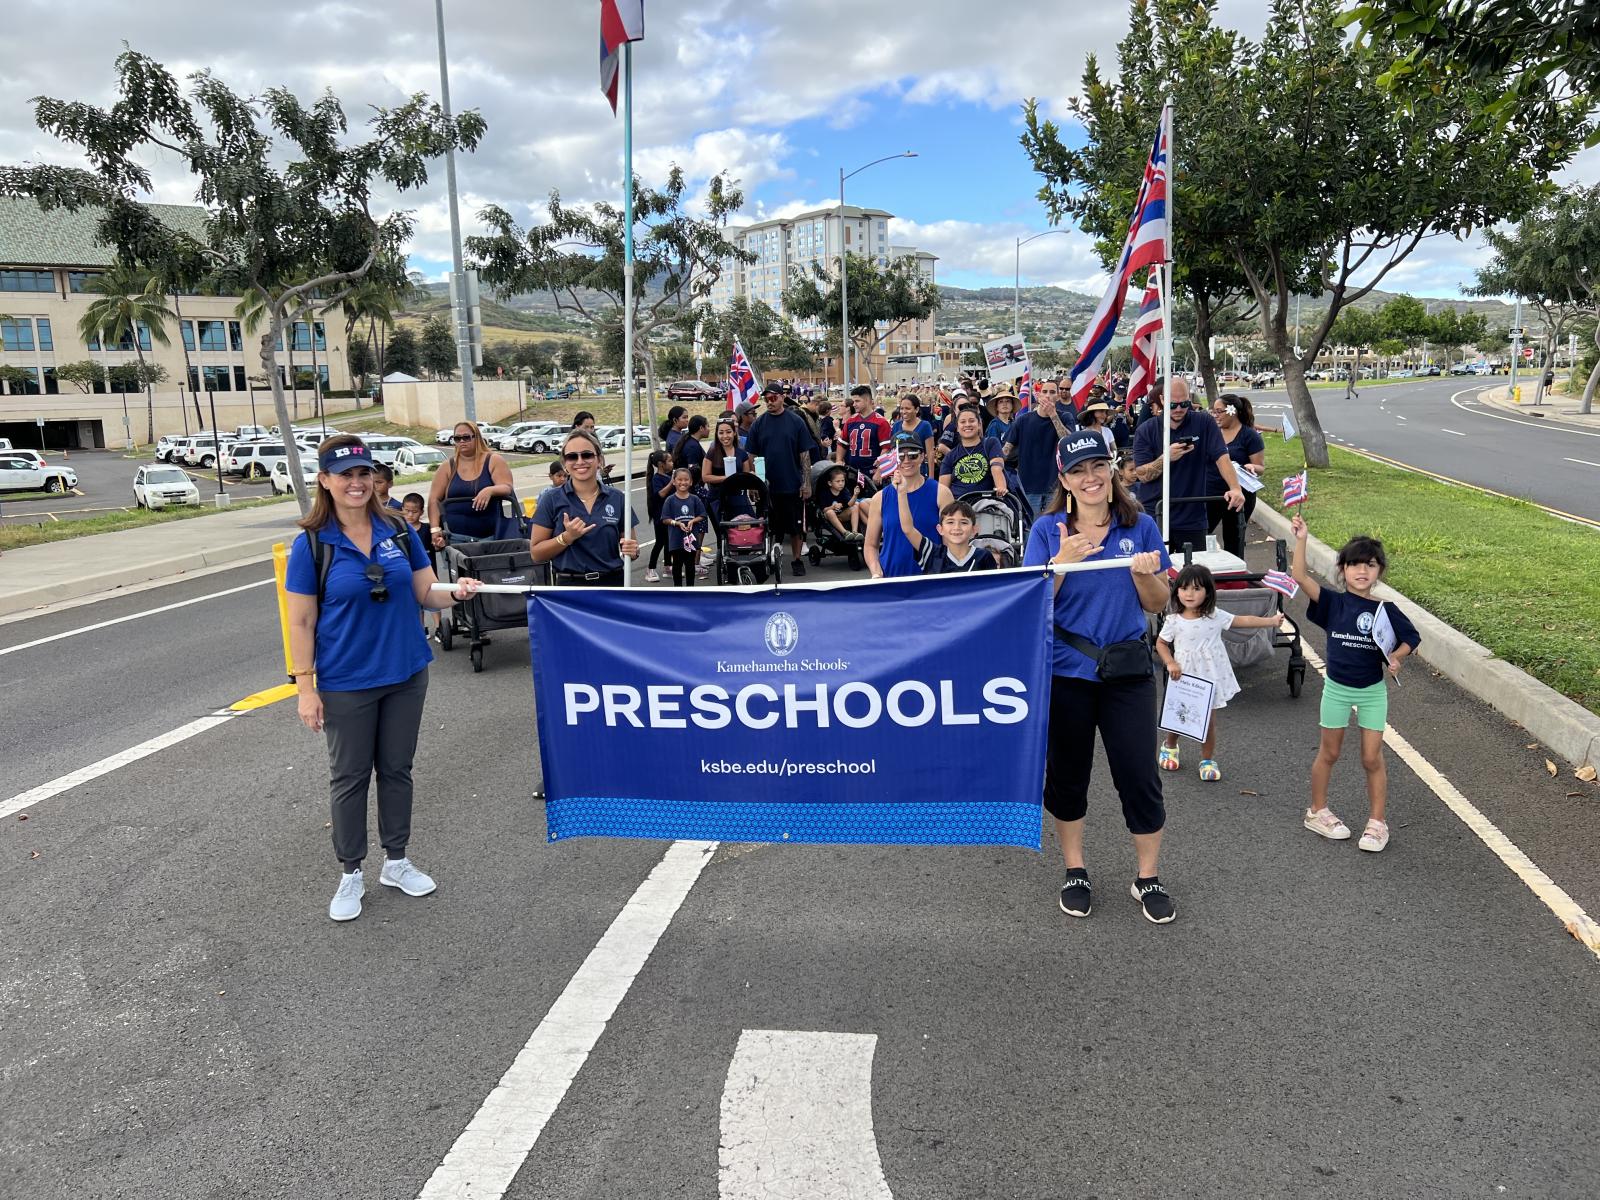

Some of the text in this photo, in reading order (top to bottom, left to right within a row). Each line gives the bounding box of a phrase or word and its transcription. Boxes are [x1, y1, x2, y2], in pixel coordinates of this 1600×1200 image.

[716, 658, 848, 673] Kamehameha Schools
[563, 676, 1029, 730] PRESCHOOLS
[700, 759, 876, 776] ksbe.edu/preschool
